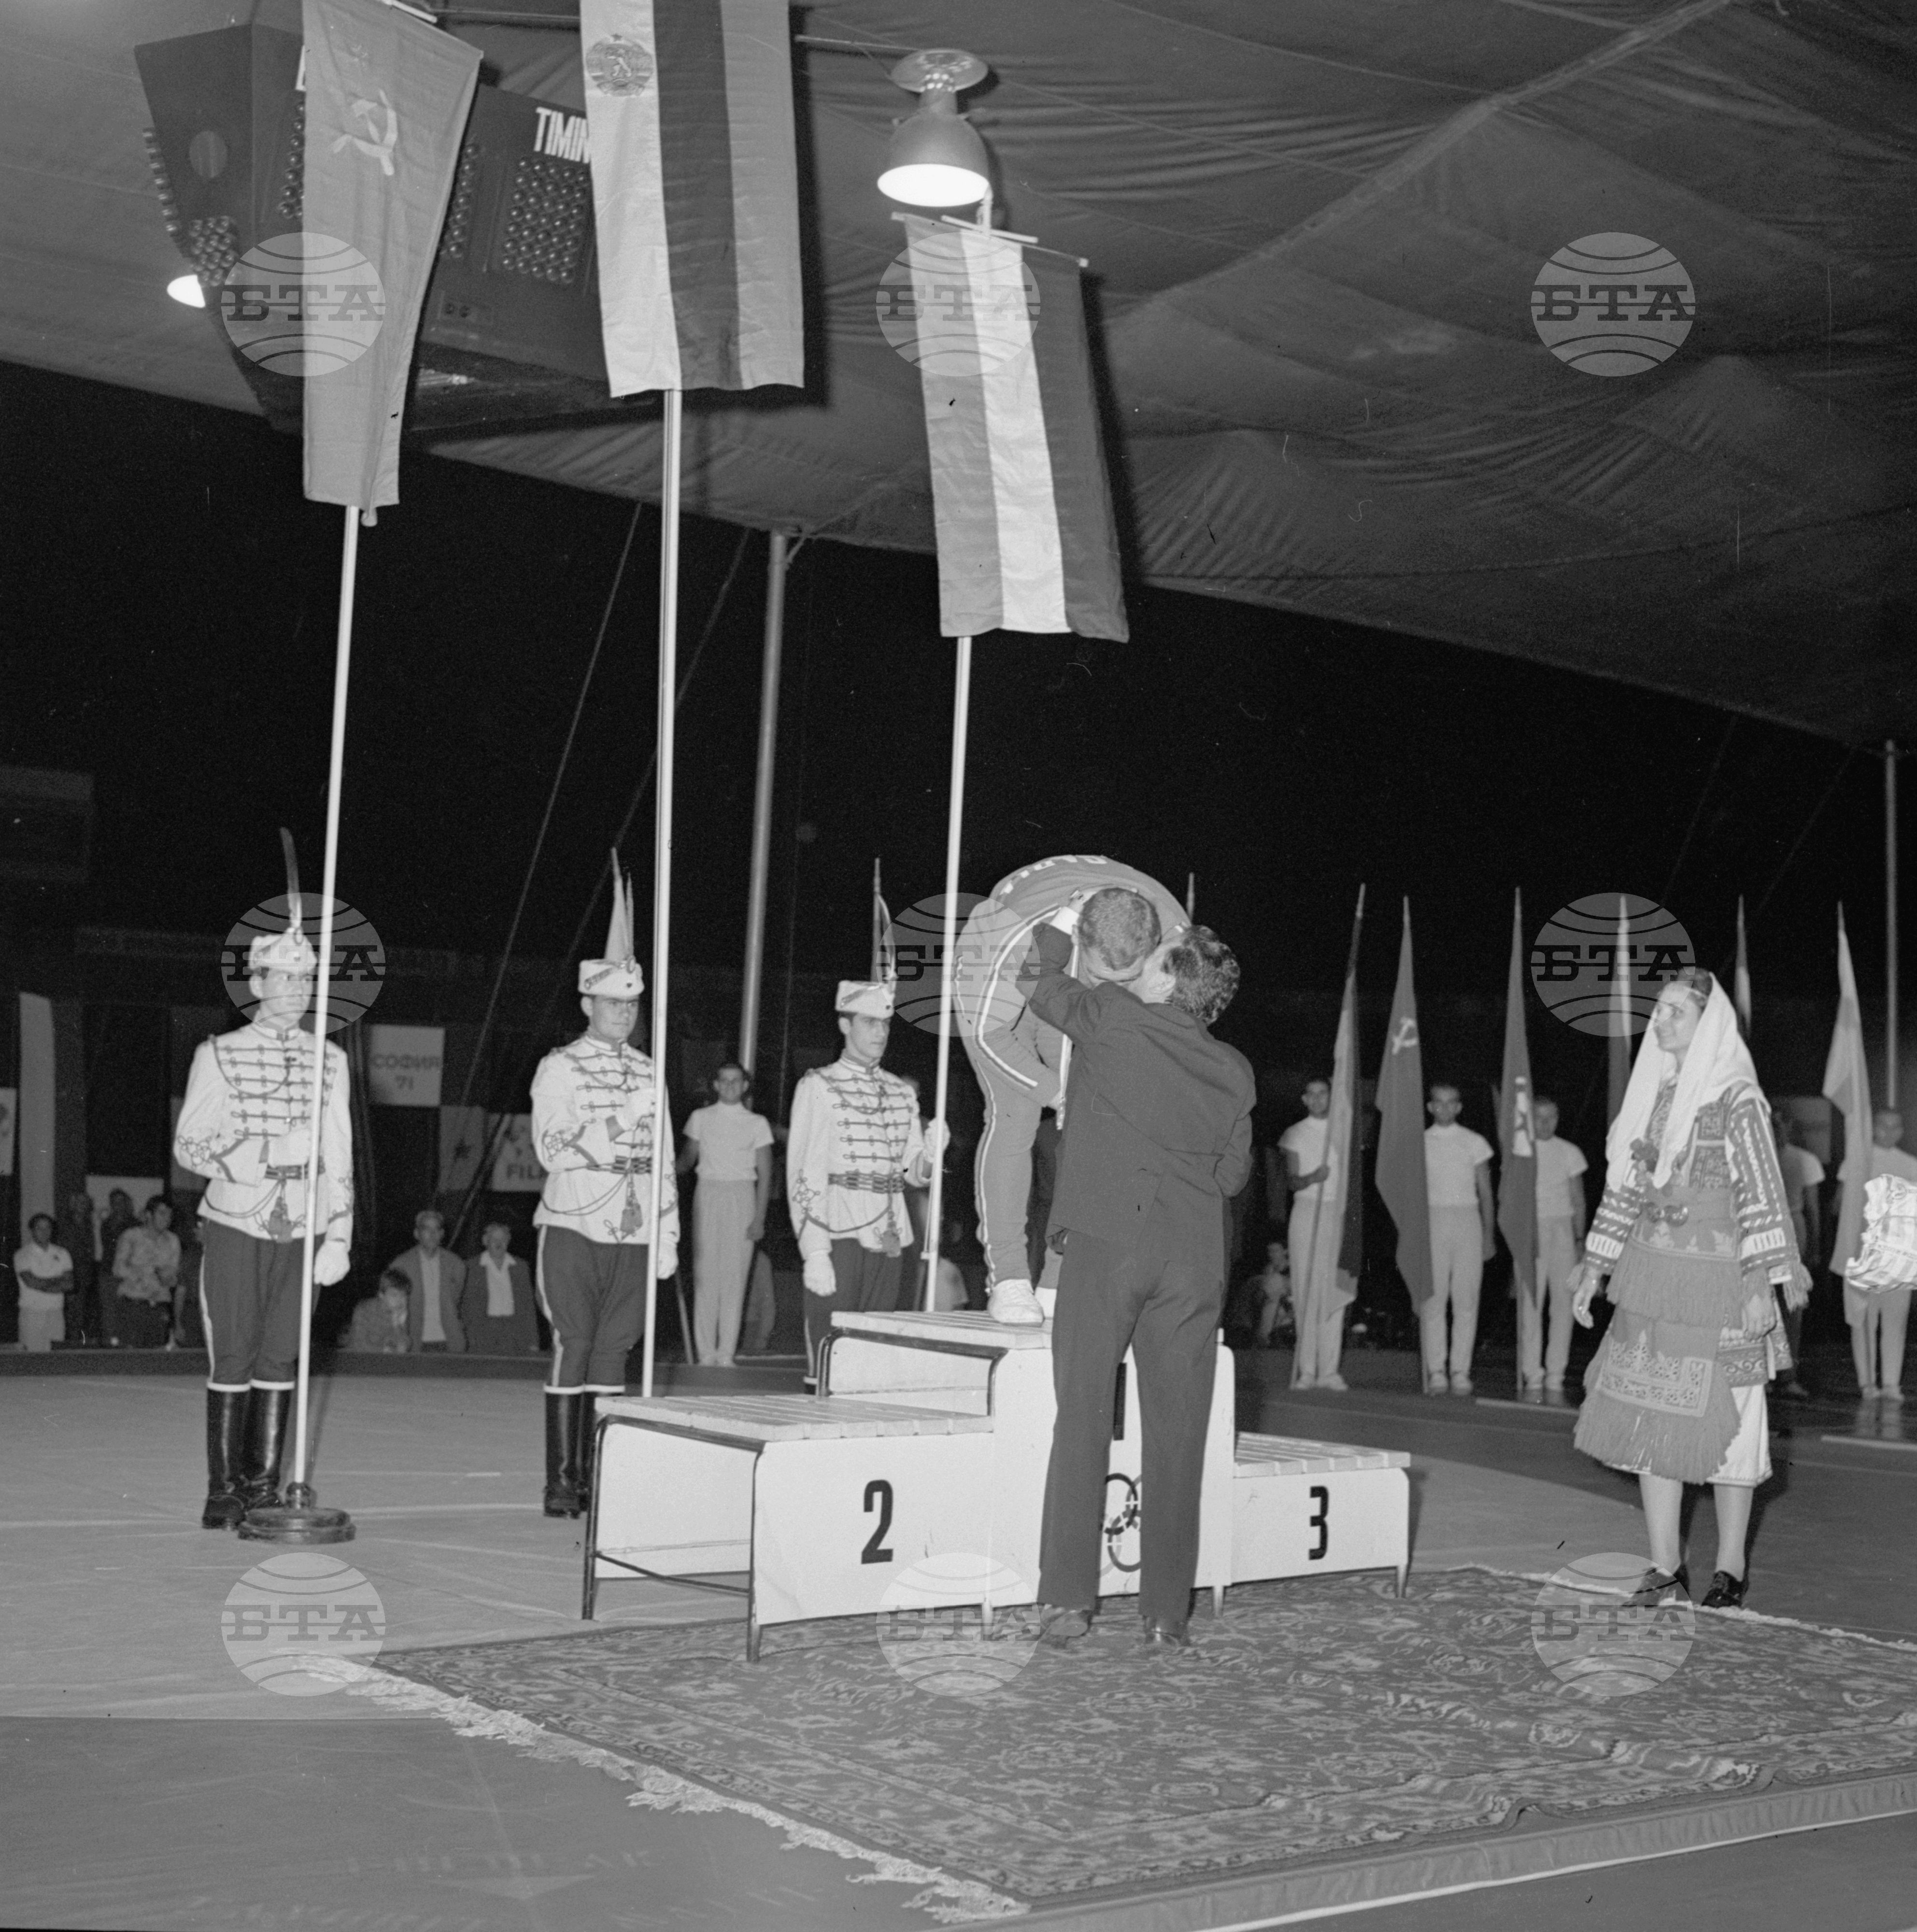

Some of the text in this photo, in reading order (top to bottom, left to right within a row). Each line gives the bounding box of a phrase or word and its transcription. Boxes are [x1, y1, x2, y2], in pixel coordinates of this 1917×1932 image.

[395, 1076, 414, 1091] 71
[861, 1479, 894, 1564] 2
[1308, 1485, 1329, 1561] 3
